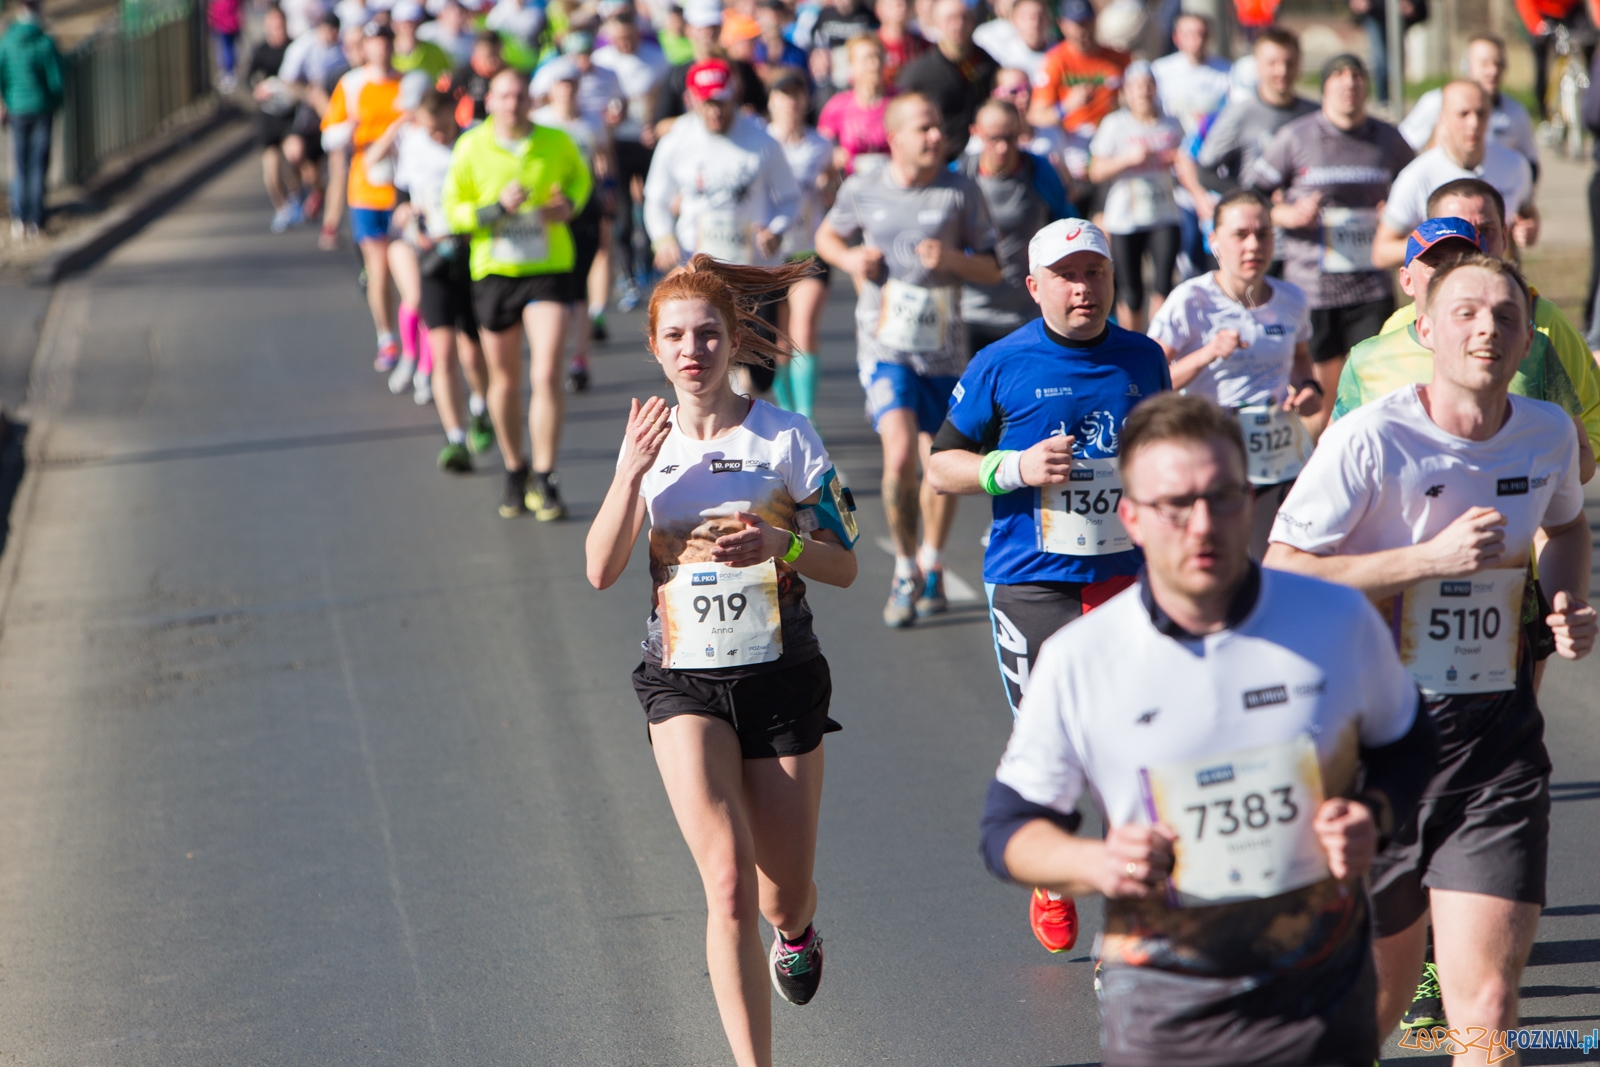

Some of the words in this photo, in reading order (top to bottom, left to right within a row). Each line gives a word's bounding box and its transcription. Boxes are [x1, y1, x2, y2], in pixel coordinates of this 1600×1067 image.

[1250, 427, 1292, 453] 5122
[1061, 488, 1123, 515] 1367
[693, 592, 747, 623] 919
[711, 627, 734, 635] Anna
[1428, 606, 1501, 640] 5110
[1184, 786, 1299, 841] 7383
